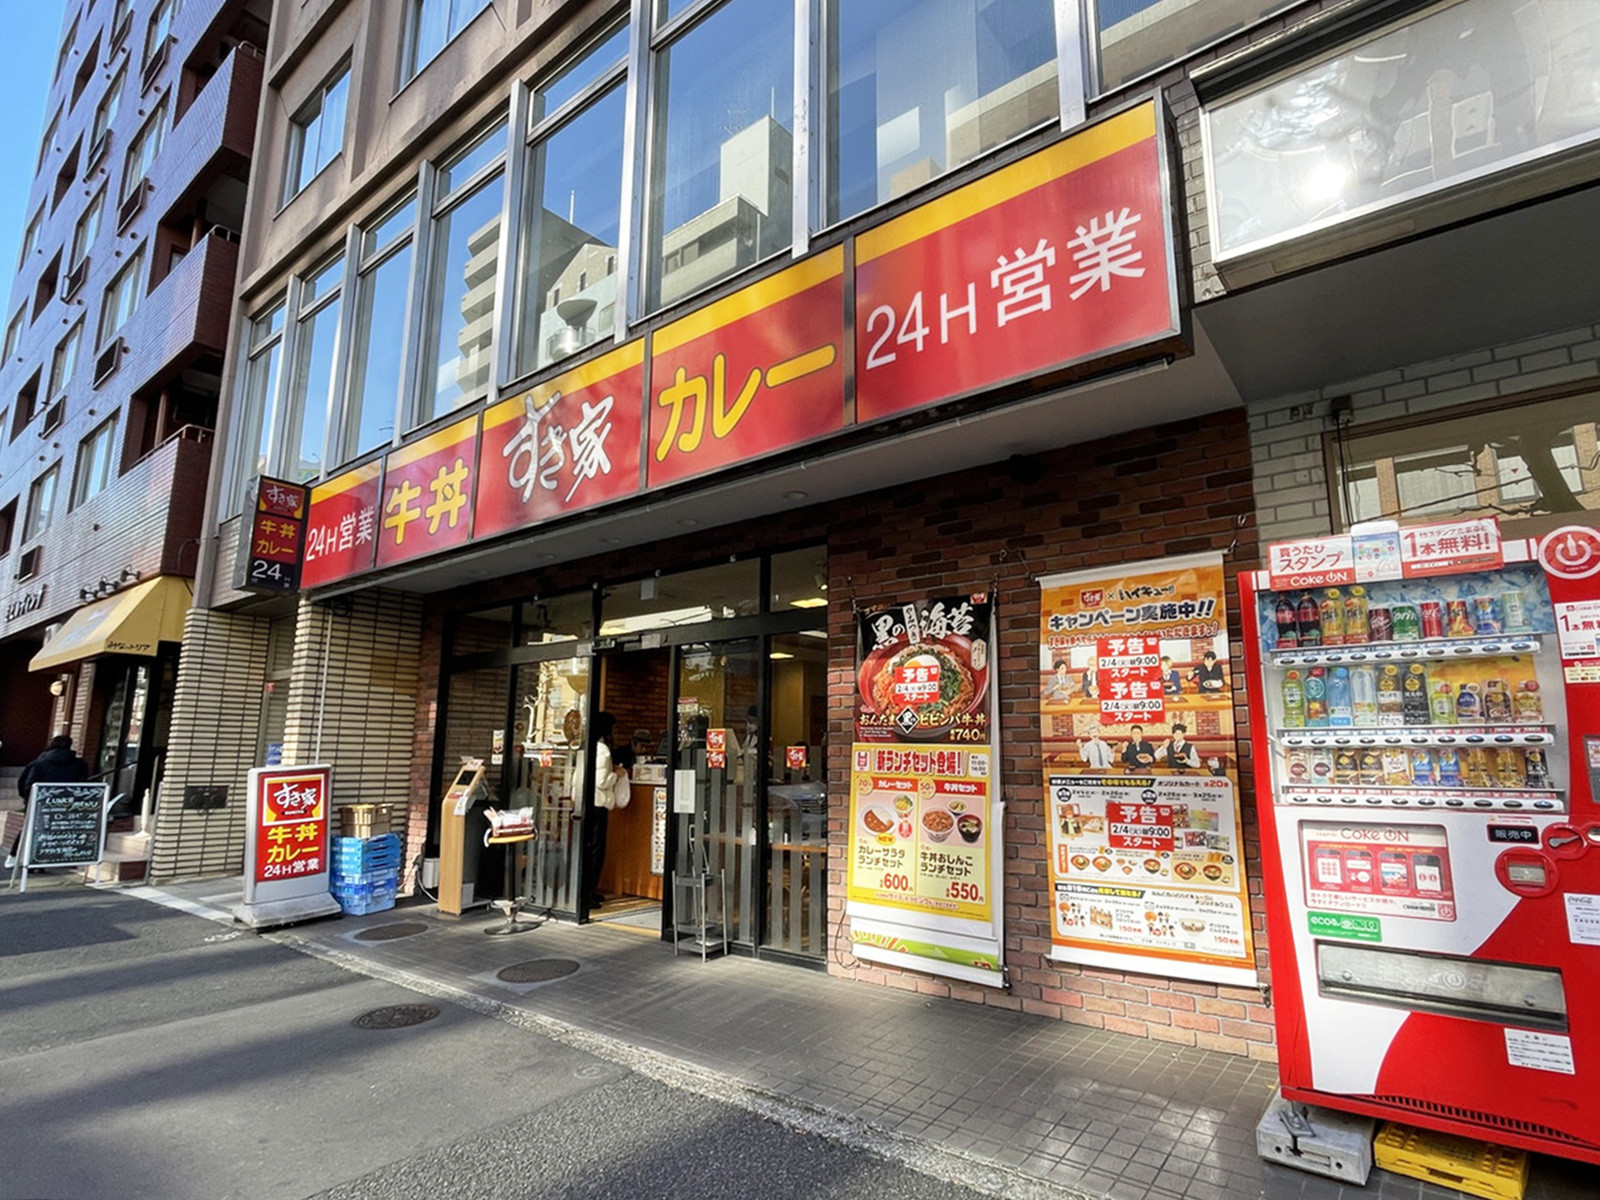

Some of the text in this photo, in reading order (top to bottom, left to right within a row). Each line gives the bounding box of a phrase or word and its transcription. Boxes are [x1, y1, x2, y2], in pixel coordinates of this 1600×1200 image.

[866, 207, 1146, 369] 24H営業
[656, 344, 836, 462] カレー
[503, 390, 614, 503] すき家
[266, 485, 299, 508] すき家
[384, 457, 469, 545] 牛丼
[260, 520, 296, 539] 牛丼
[306, 505, 374, 562] 24H営業
[256, 539, 294, 555] カレー
[1279, 544, 1325, 558] 買うたび
[252, 560, 282, 580] 24
[1280, 551, 1344, 573] スタンプ
[1290, 571, 1348, 587] Coke ON
[1107, 638, 1144, 655] 予告
[902, 668, 929, 682] 予告
[1111, 667, 1148, 678] スタート
[904, 693, 930, 702] スタート
[1110, 681, 1148, 699] 予告
[1115, 711, 1152, 722] スタート
[878, 780, 913, 789] カレーセット
[273, 783, 317, 809] すき家
[1119, 805, 1158, 823] 予告
[267, 823, 318, 844] 牛丼
[1340, 827, 1380, 841] Coke
[1494, 829, 1533, 840] 販売中
[1123, 837, 1161, 848] スタート
[267, 844, 319, 864] カレー
[858, 856, 904, 869] ランチセット
[920, 852, 973, 867] 牛丼おしんこ
[264, 858, 319, 877] 24H営業
[920, 862, 972, 877] ランチセット
